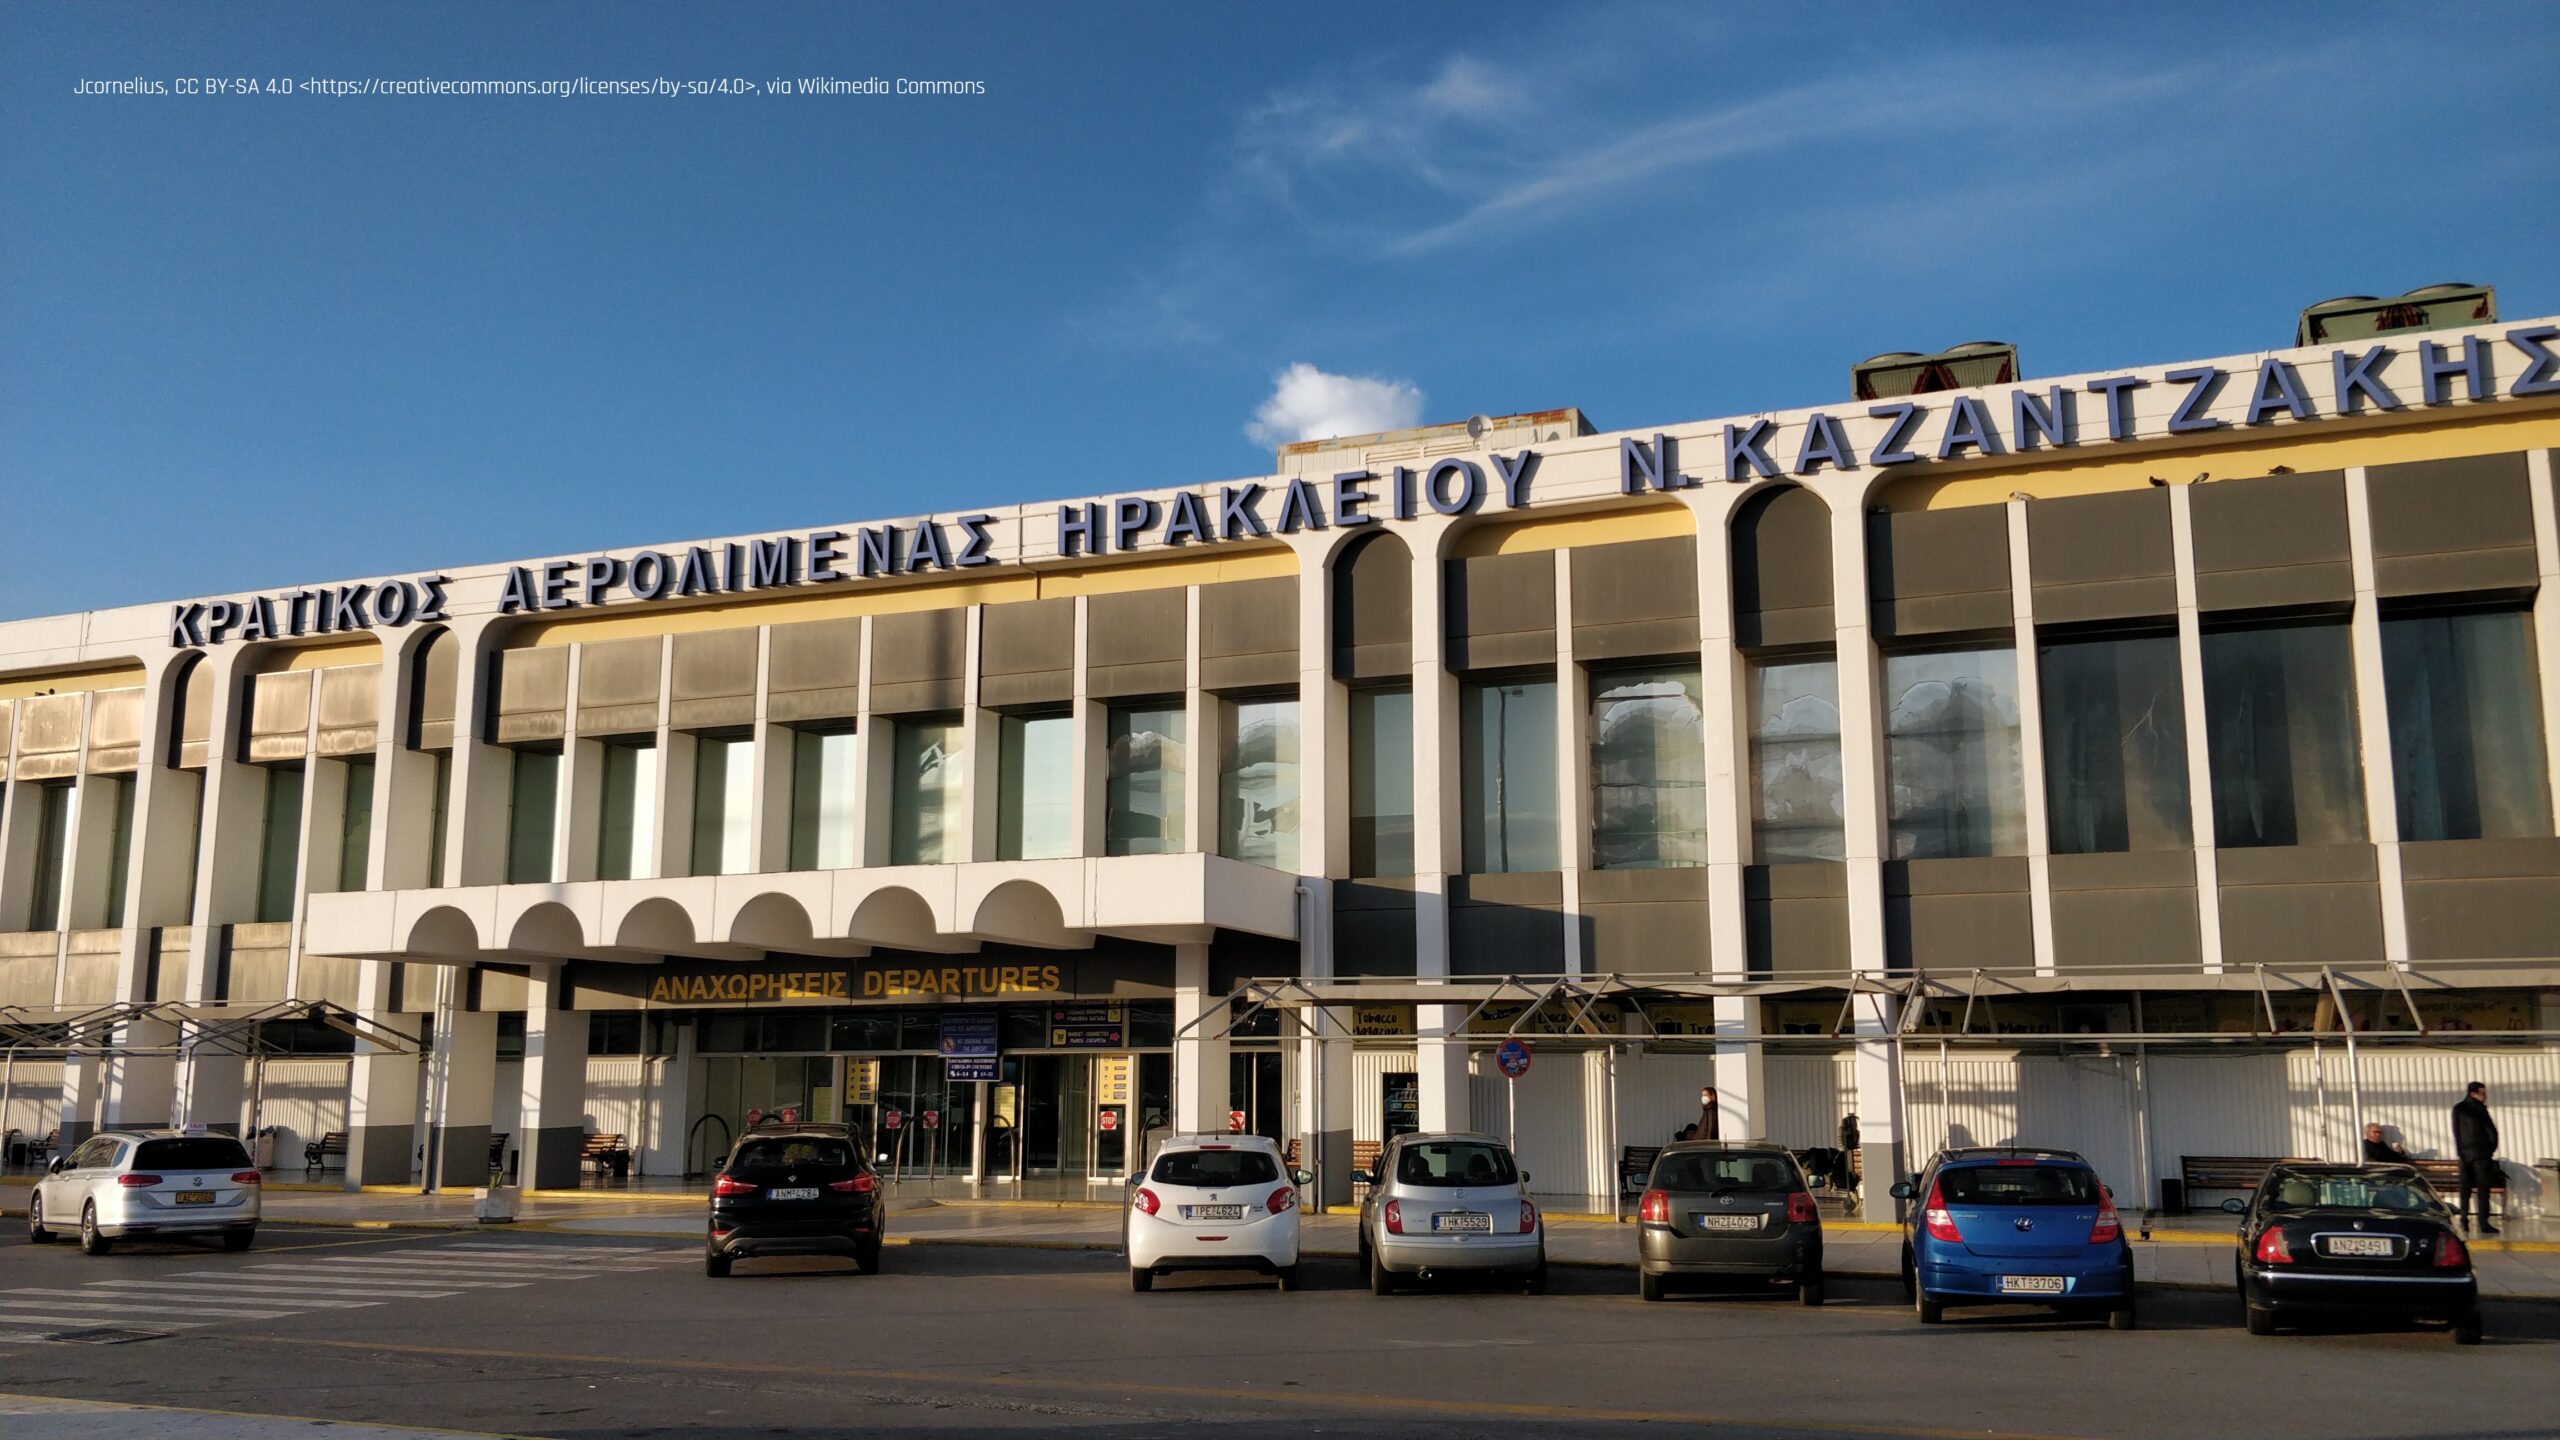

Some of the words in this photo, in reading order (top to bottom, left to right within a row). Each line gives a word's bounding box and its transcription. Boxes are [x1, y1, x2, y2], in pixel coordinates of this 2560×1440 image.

[169, 574, 448, 647] ΚΡΑΤΙΚΟΣ
[497, 513, 992, 613] ΑΕΡΟΛΙΜΕΝΑΣ
[1057, 450, 1536, 556] ΗΡΑΚΛΕΙΟΥ
[1619, 432, 1688, 494] Ν.
[1723, 324, 2560, 483] ΚΑΖΑΝΤΖΑΚΗΣ
[651, 971, 848, 1000] ΑΝΑΧΩΡΗΣΕΙΣ
[864, 965, 1061, 996] DEPARTURES
[1357, 1012, 1397, 1024] Tobacco
[886, 1116, 901, 1124] STOP
[1100, 1116, 1117, 1125] STOP
